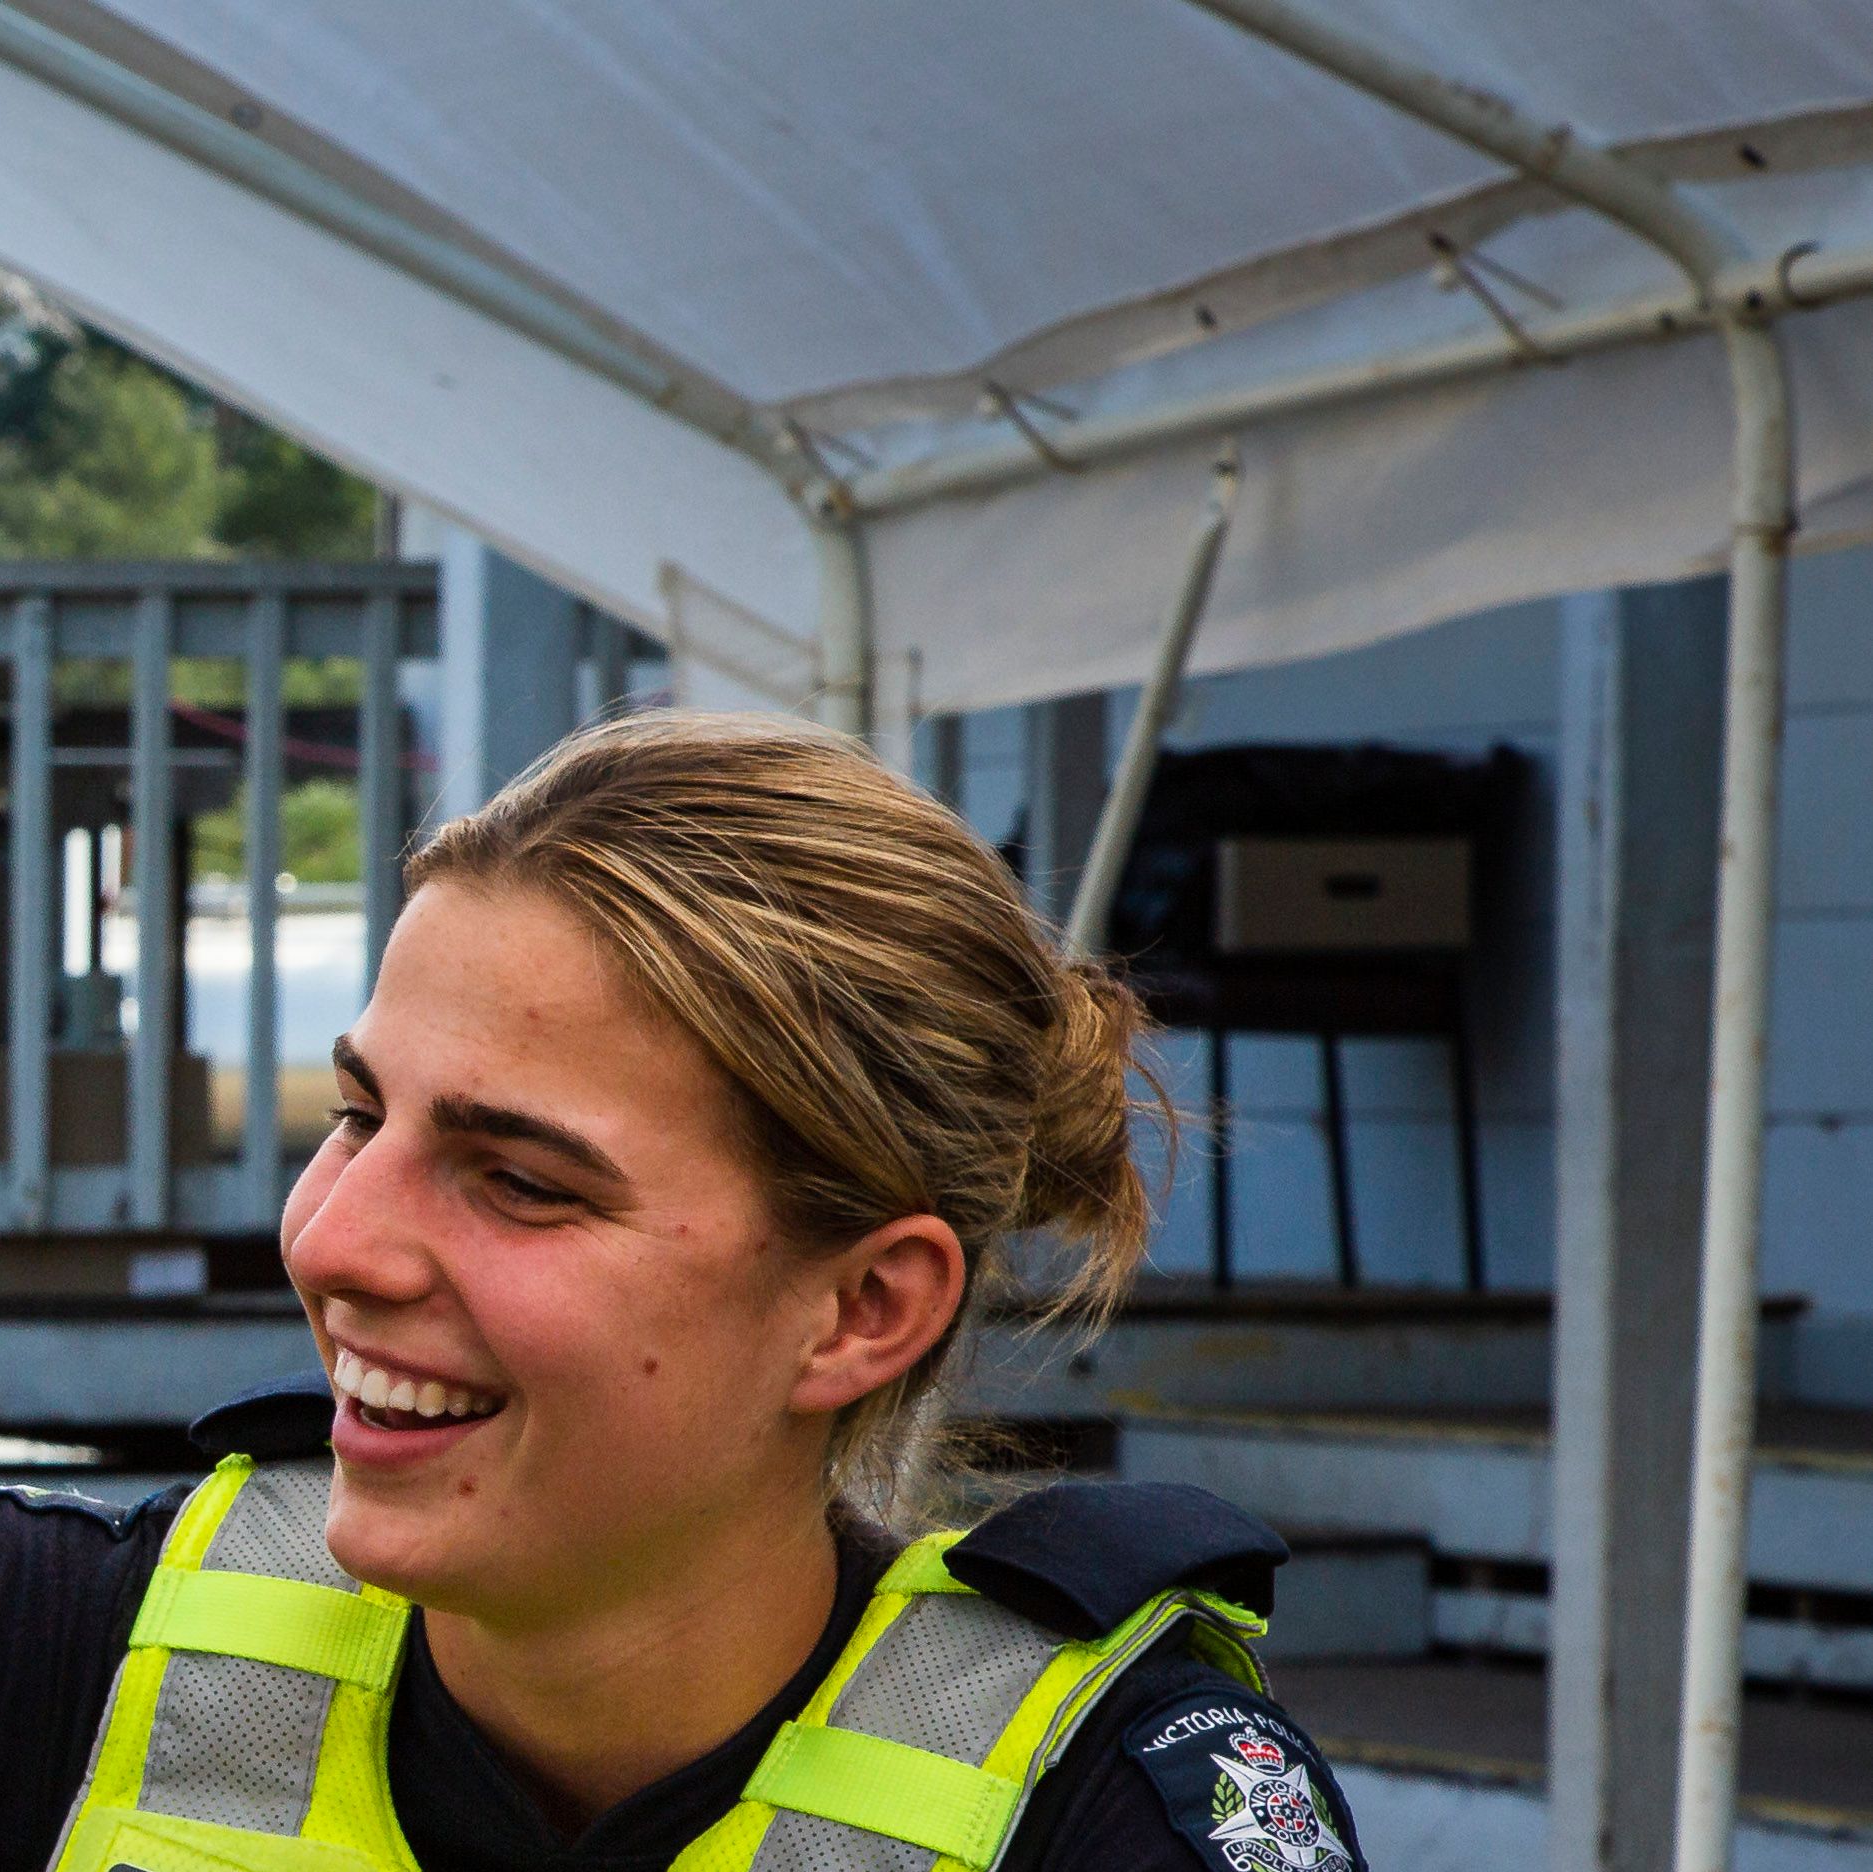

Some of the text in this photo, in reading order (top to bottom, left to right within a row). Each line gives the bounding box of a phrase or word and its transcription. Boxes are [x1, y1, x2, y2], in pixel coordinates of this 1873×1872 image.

[1143, 1707, 1254, 1752] VICTORIA
[1250, 1781, 1312, 1816] VICTORIA
[1263, 1822, 1317, 1847] POLICE
[1231, 1842, 1293, 1872] UPHOLD
